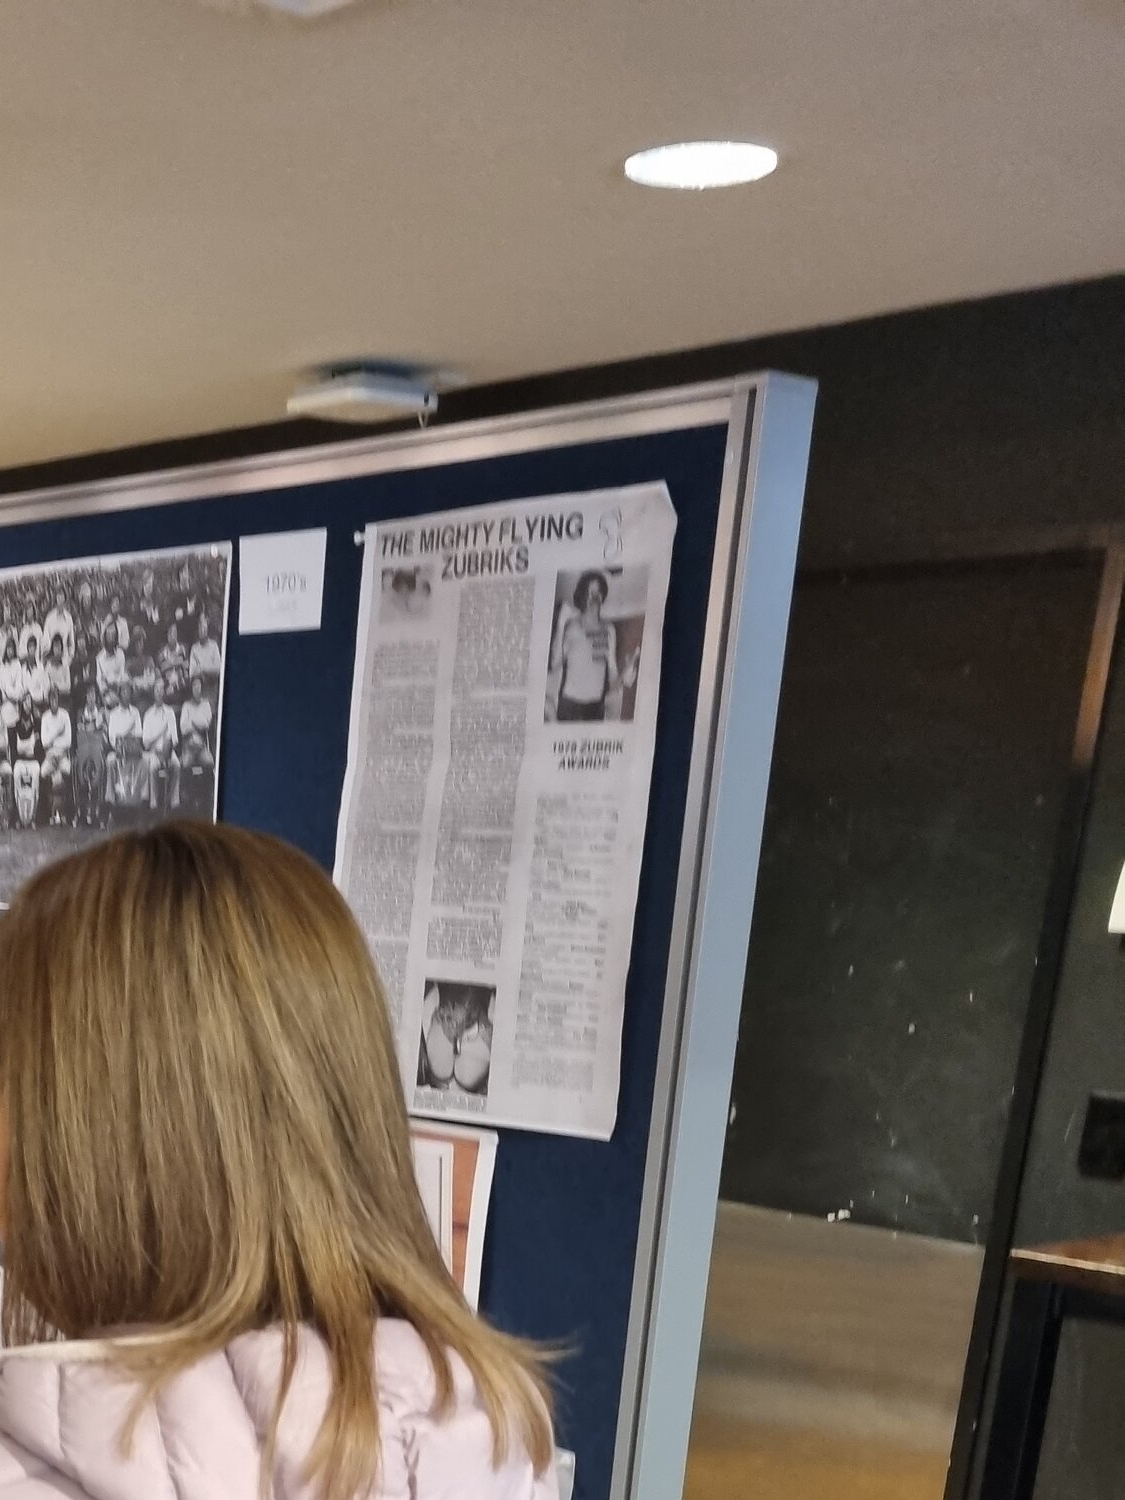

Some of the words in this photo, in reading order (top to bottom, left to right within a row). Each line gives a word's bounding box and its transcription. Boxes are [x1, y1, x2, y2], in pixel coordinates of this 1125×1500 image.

[380, 529, 414, 558] THE
[419, 518, 496, 554] MIGHTY
[498, 511, 584, 544] FLYING
[441, 544, 530, 581] ZUBRIKS
[558, 755, 610, 771] AWARDS
